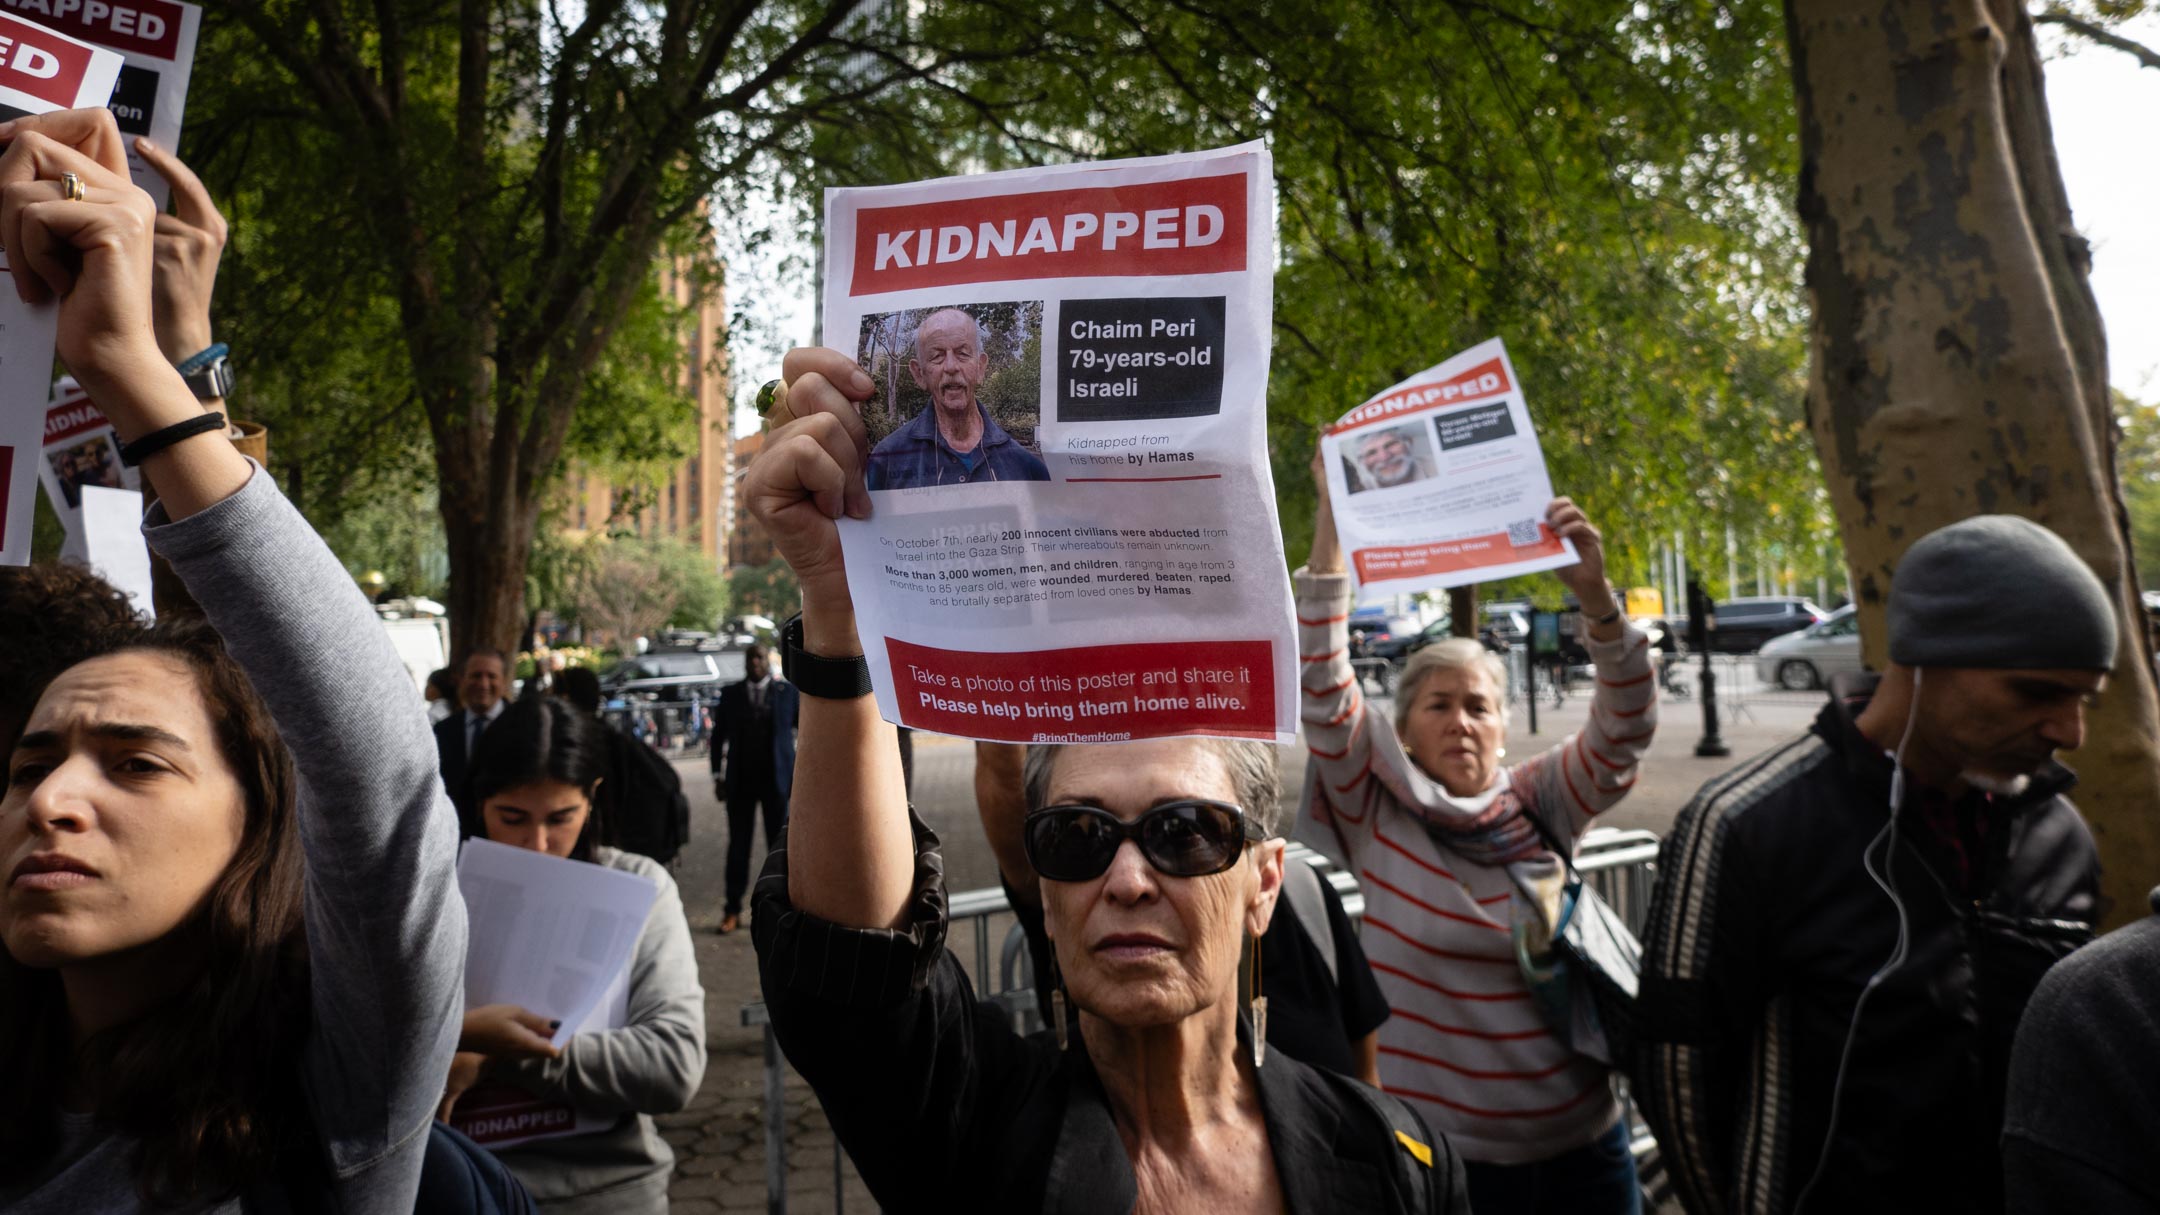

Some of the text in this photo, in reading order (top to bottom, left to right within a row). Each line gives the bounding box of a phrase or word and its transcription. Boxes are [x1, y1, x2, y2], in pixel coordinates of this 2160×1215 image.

[0, 0, 165, 40] APPED
[874, 204, 1225, 271] KIDNAPPED
[1070, 318, 1196, 339] Chaim Peri
[1069, 346, 1211, 373] 79-years-old
[1069, 377, 1138, 398] Israeli
[45, 405, 105, 435] IDNA
[1068, 434, 1170, 450] Kidnapped from
[1069, 451, 1195, 466] his home by Hamas
[880, 537, 893, 547] On
[896, 538, 939, 549] October
[943, 535, 963, 546] 7th,
[966, 532, 999, 545] nearly
[1001, 530, 1021, 541] 200
[1024, 527, 1071, 539] innocent
[1074, 527, 1118, 538] civilians
[1149, 528, 1200, 538] abducted
[1203, 528, 1228, 537] from
[896, 540, 1213, 561] Israel into the Gaza Strip. Their whereabouts remain unknown.
[885, 559, 1235, 581] More than 3,000 women, men, and children, ranging in age from 3
[890, 572, 1235, 594] months to 85 years old, were wounded, murdered, beaten, raped,
[930, 585, 1194, 607] and brutally separated from loved ones by Hamas.
[908, 664, 1250, 693] Take a photo of this poster and share it
[919, 692, 1246, 721] Please help bring them home alive.
[1032, 732, 1131, 742] #BringThemHome
